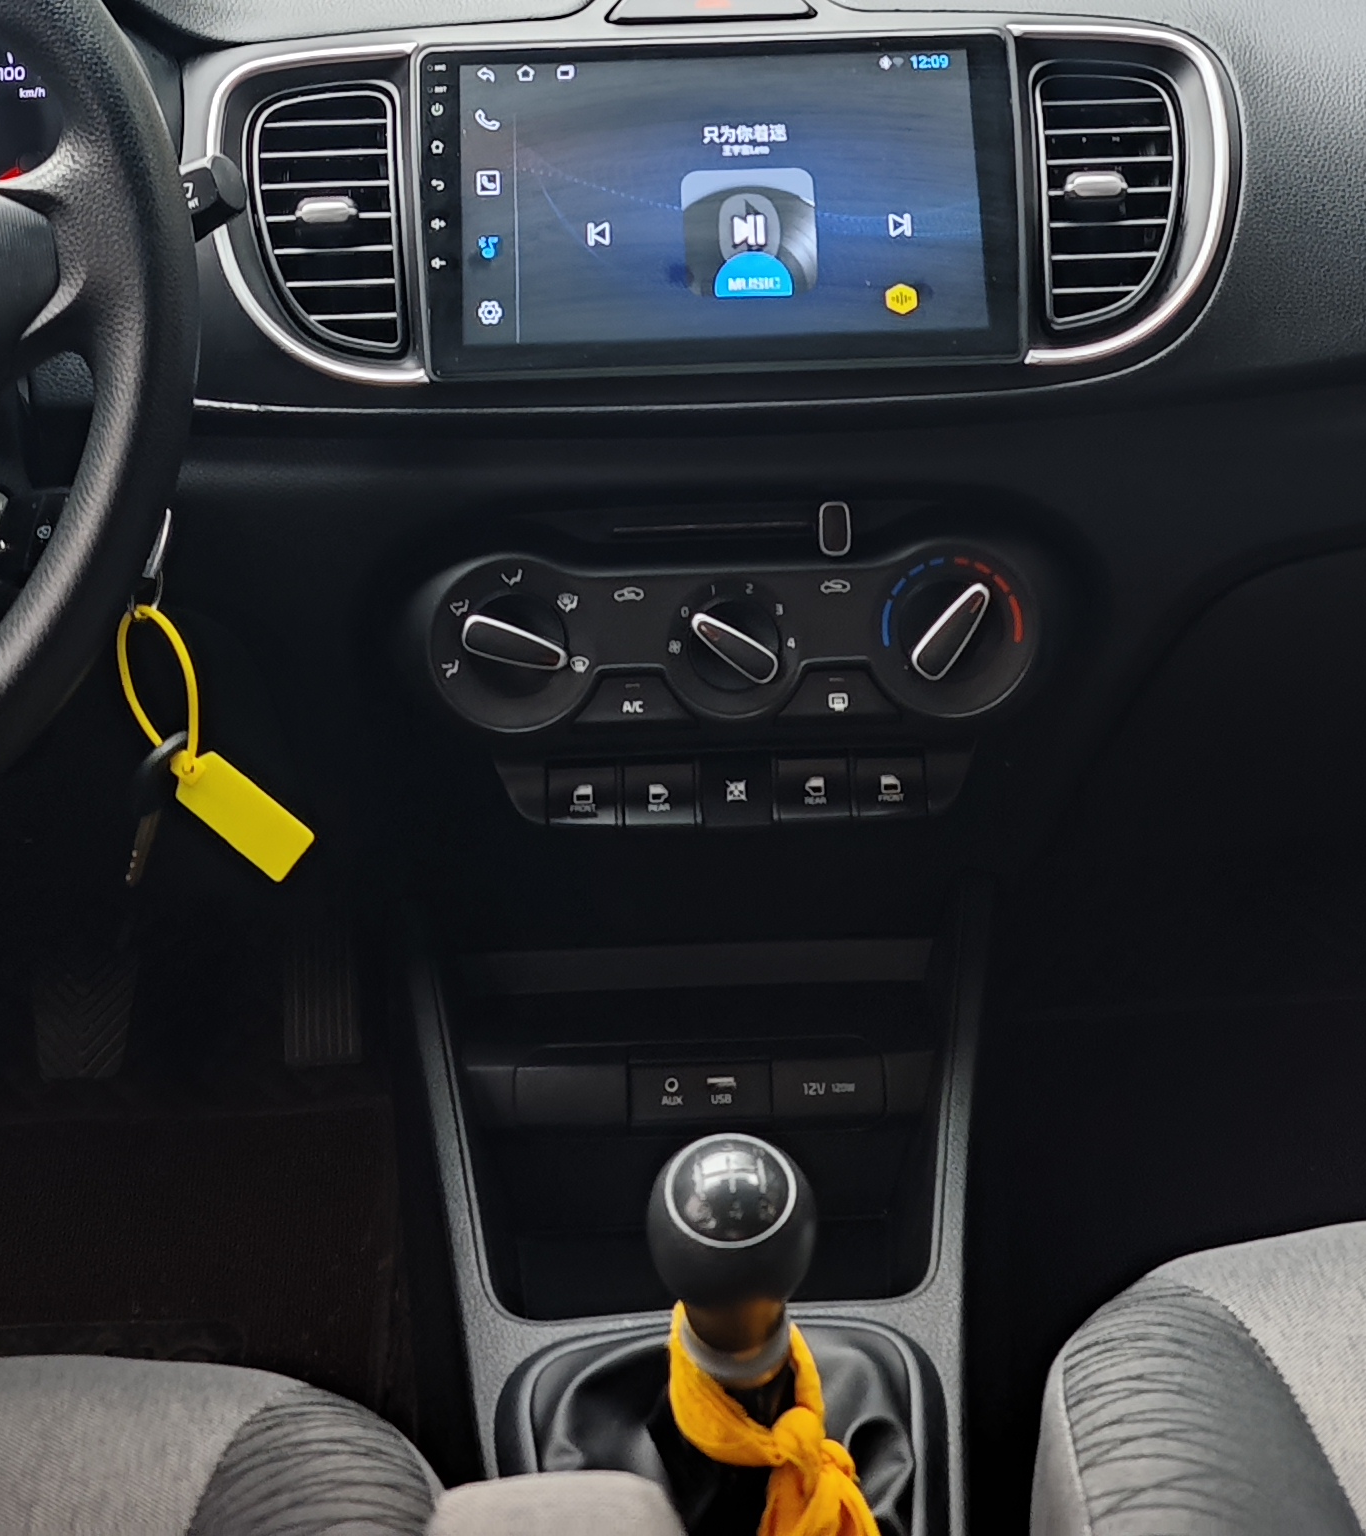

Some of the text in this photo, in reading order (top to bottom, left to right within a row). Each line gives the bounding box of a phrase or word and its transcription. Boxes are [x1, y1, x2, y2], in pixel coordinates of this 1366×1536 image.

[910, 54, 950, 70] 12:09
[19, 86, 46, 98] km/h
[745, 582, 754, 595] 2
[786, 636, 796, 649] 4
[621, 700, 644, 713] A/C
[804, 795, 827, 805] REAR
[877, 792, 905, 802] FRONT
[569, 803, 597, 813] FRONT
[802, 1082, 827, 1095] 12V
[660, 1095, 684, 1107] AUX
[710, 1093, 733, 1105] USB
